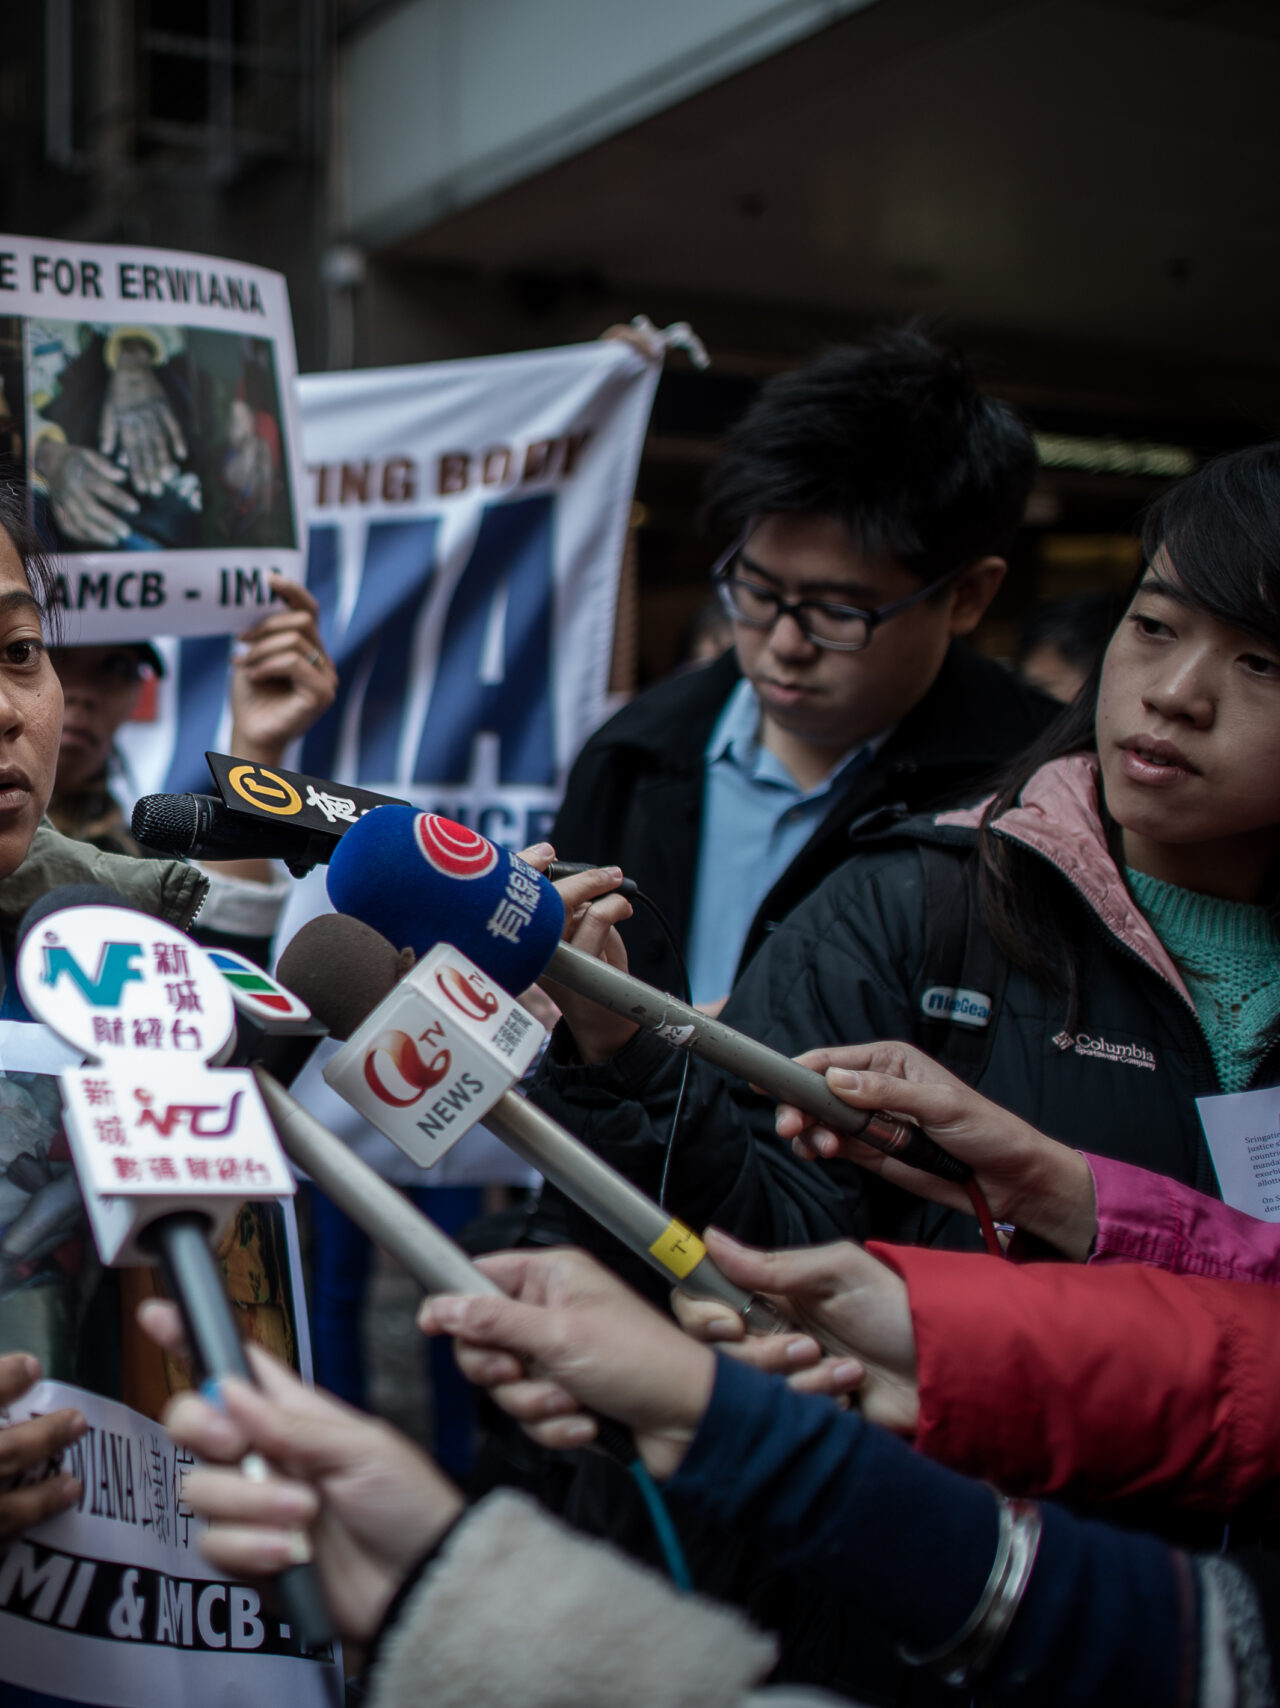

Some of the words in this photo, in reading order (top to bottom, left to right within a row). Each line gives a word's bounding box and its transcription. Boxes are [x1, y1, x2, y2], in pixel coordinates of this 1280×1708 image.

[31, 255, 104, 299] FOR
[118, 262, 266, 317] ERWIANA
[307, 452, 414, 506] ING
[437, 430, 597, 497] BODY
[52, 570, 166, 610] AMCB
[418, 1020, 447, 1048] TV
[1076, 1033, 1156, 1063] Columbia
[416, 1073, 485, 1140] NEWS
[1248, 1143, 1274, 1154] justice
[109, 1569, 144, 1638] &
[157, 1575, 265, 1650] AMCB
